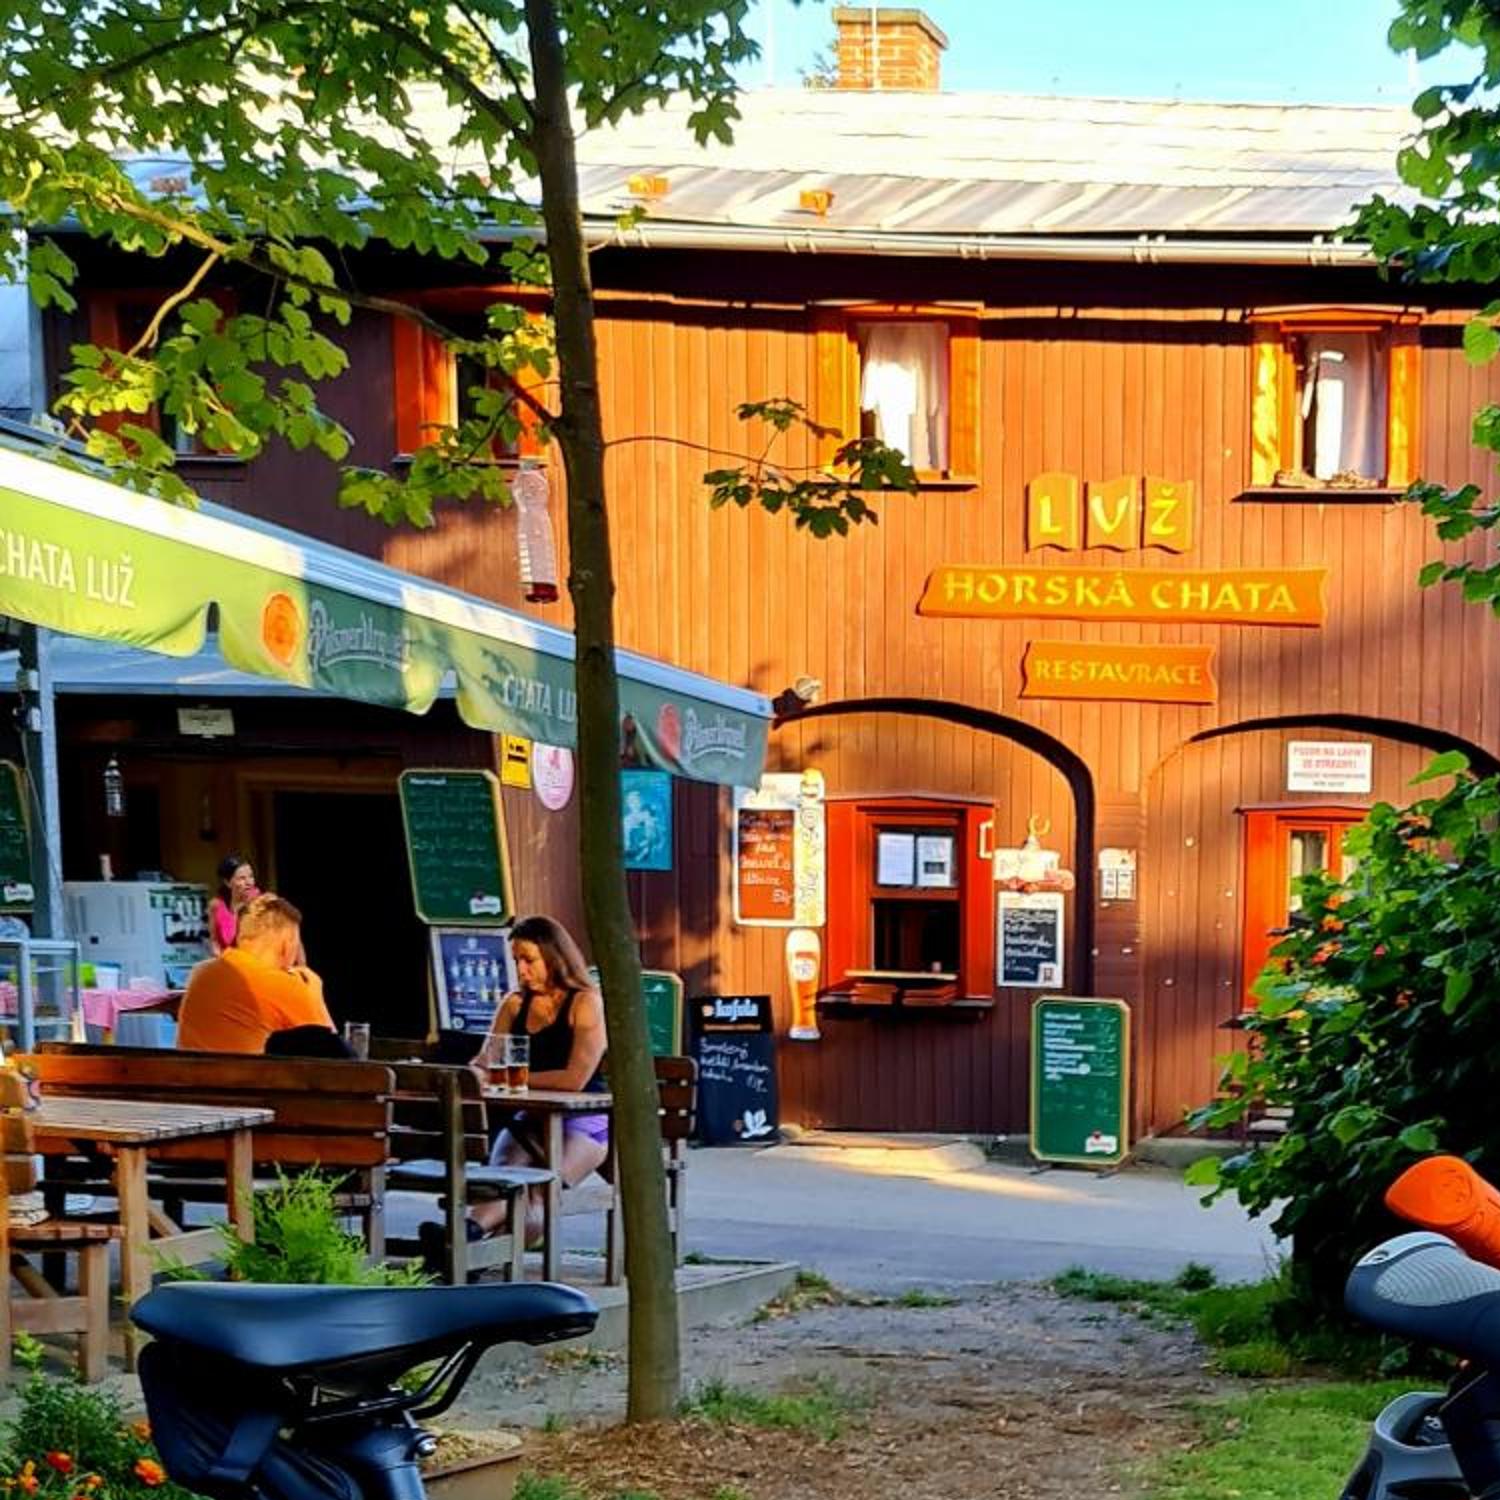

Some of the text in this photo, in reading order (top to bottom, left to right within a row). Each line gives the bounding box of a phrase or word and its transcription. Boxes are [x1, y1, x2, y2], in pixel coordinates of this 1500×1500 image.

[86, 553, 135, 608] LUŽ
[943, 570, 1298, 614] HORSKÁ CHATA
[503, 673, 551, 719] CHATA
